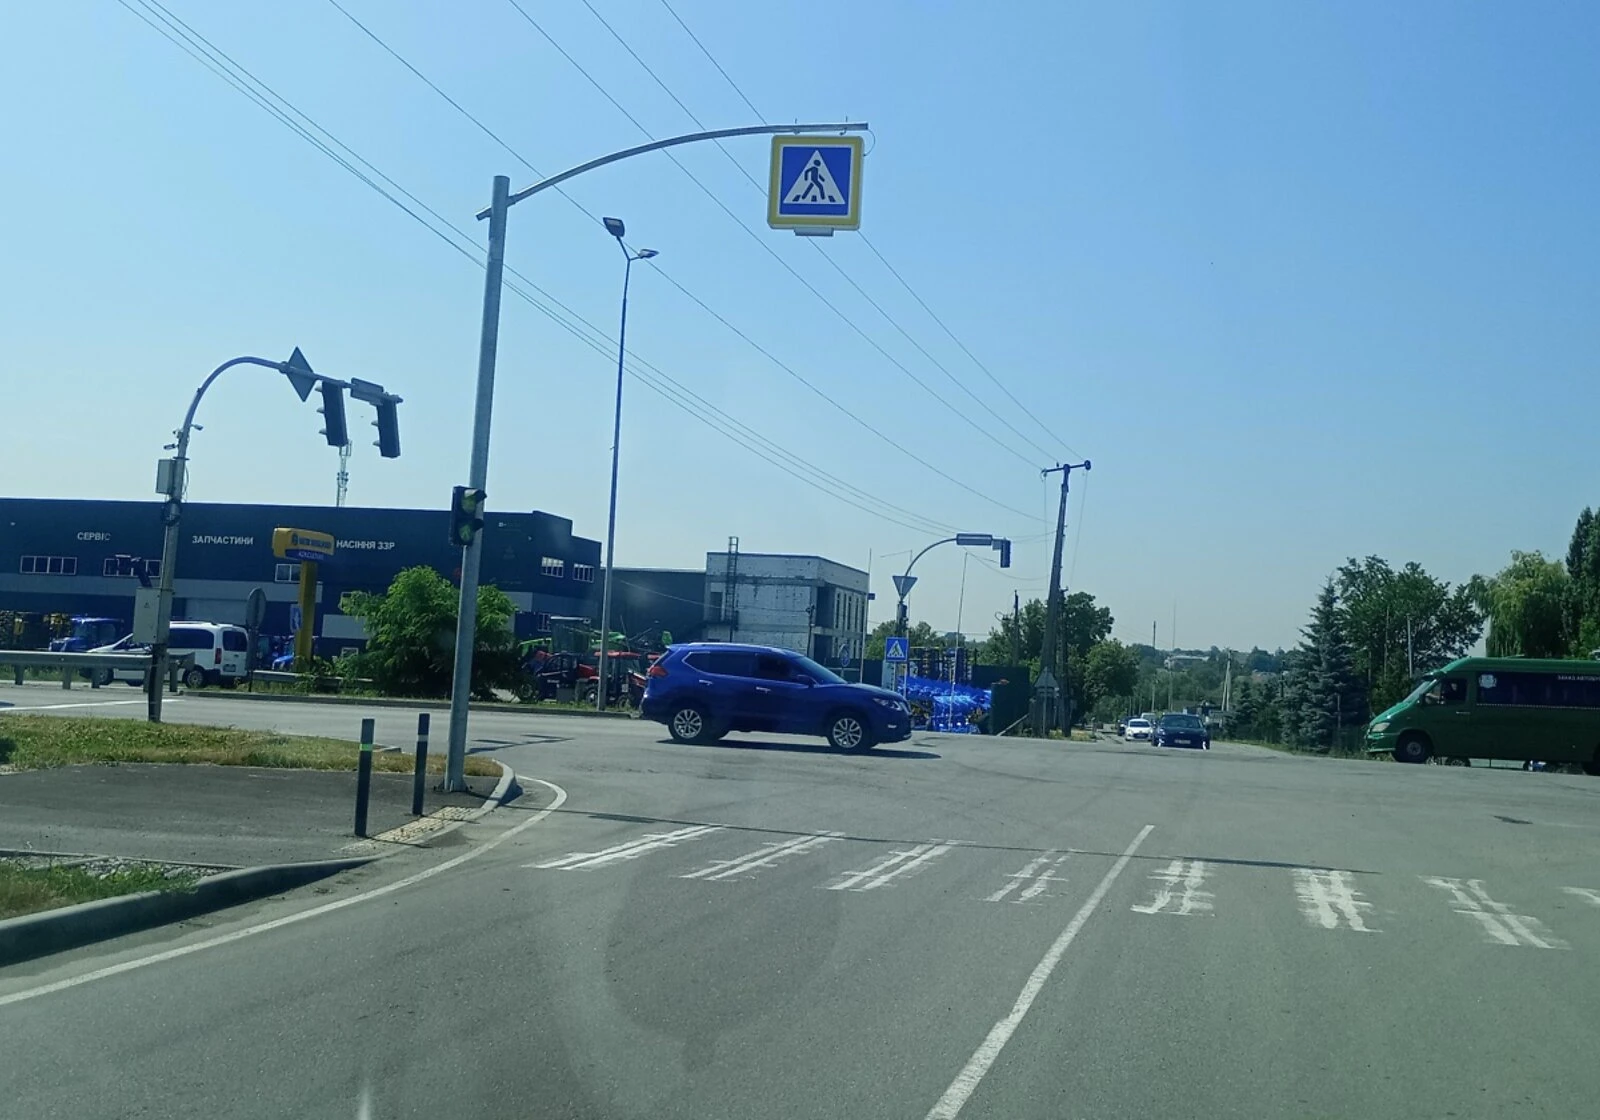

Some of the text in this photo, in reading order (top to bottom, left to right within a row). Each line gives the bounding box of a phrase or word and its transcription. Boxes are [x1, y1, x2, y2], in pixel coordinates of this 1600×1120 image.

[77, 532, 112, 541] СЕРВІС
[192, 535, 254, 545] ЗАПЧАСТИНИ
[336, 539, 376, 550] НАСІННЯ
[378, 541, 395, 550] ЗЗР
